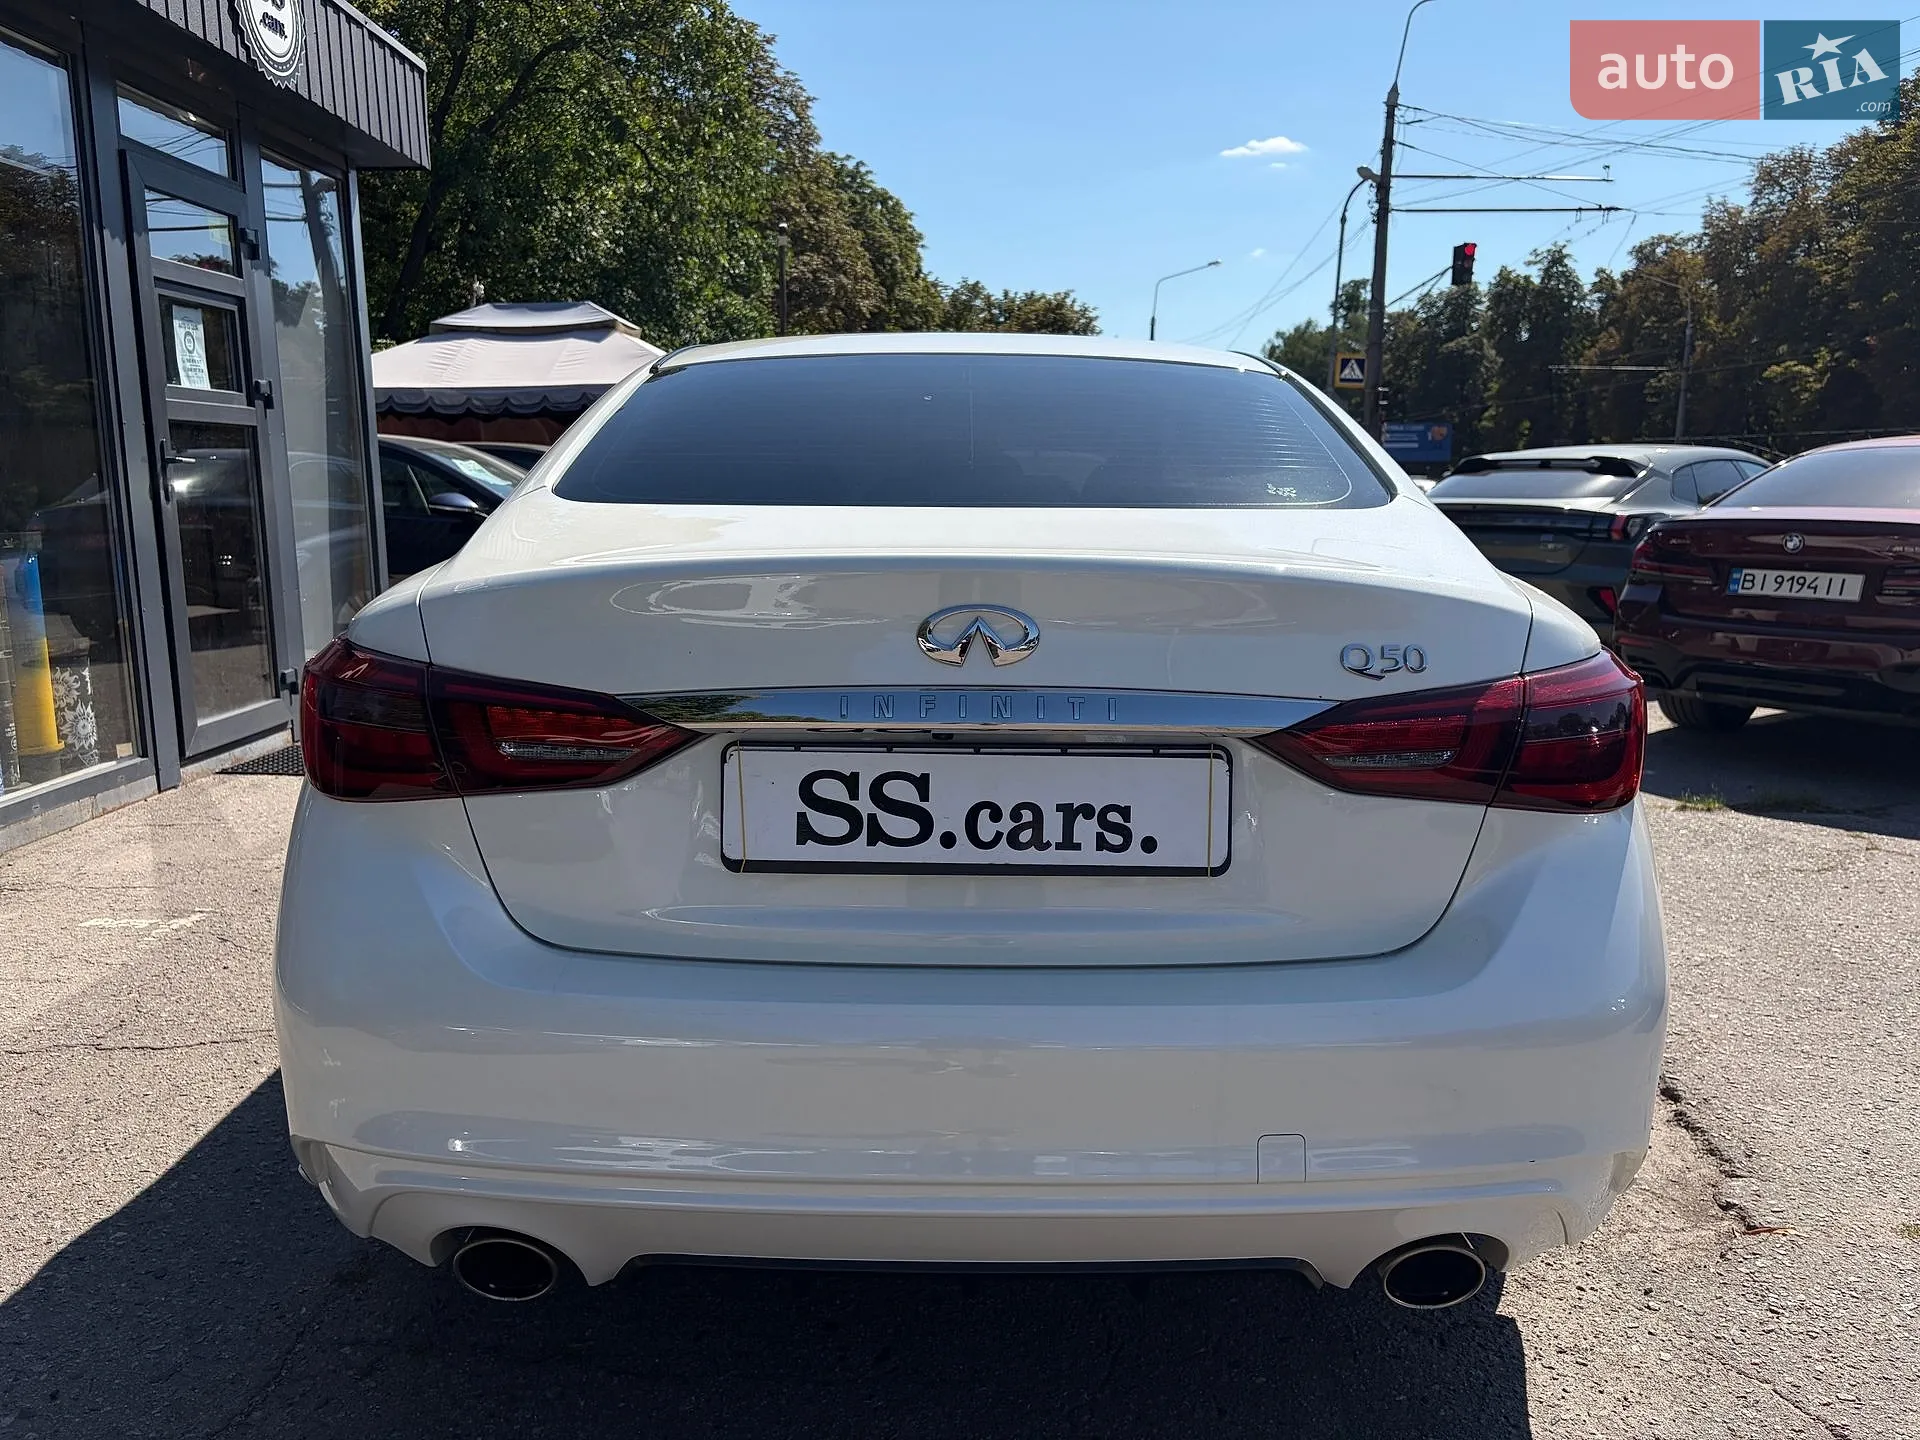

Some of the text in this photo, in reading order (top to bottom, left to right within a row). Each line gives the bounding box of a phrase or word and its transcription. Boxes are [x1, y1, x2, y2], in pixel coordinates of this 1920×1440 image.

[1773, 574, 1820, 595] 9194
[1340, 643, 1428, 681] Q50
[839, 695, 1118, 721] INFINITI
[796, 769, 1159, 854] SS.cars.
